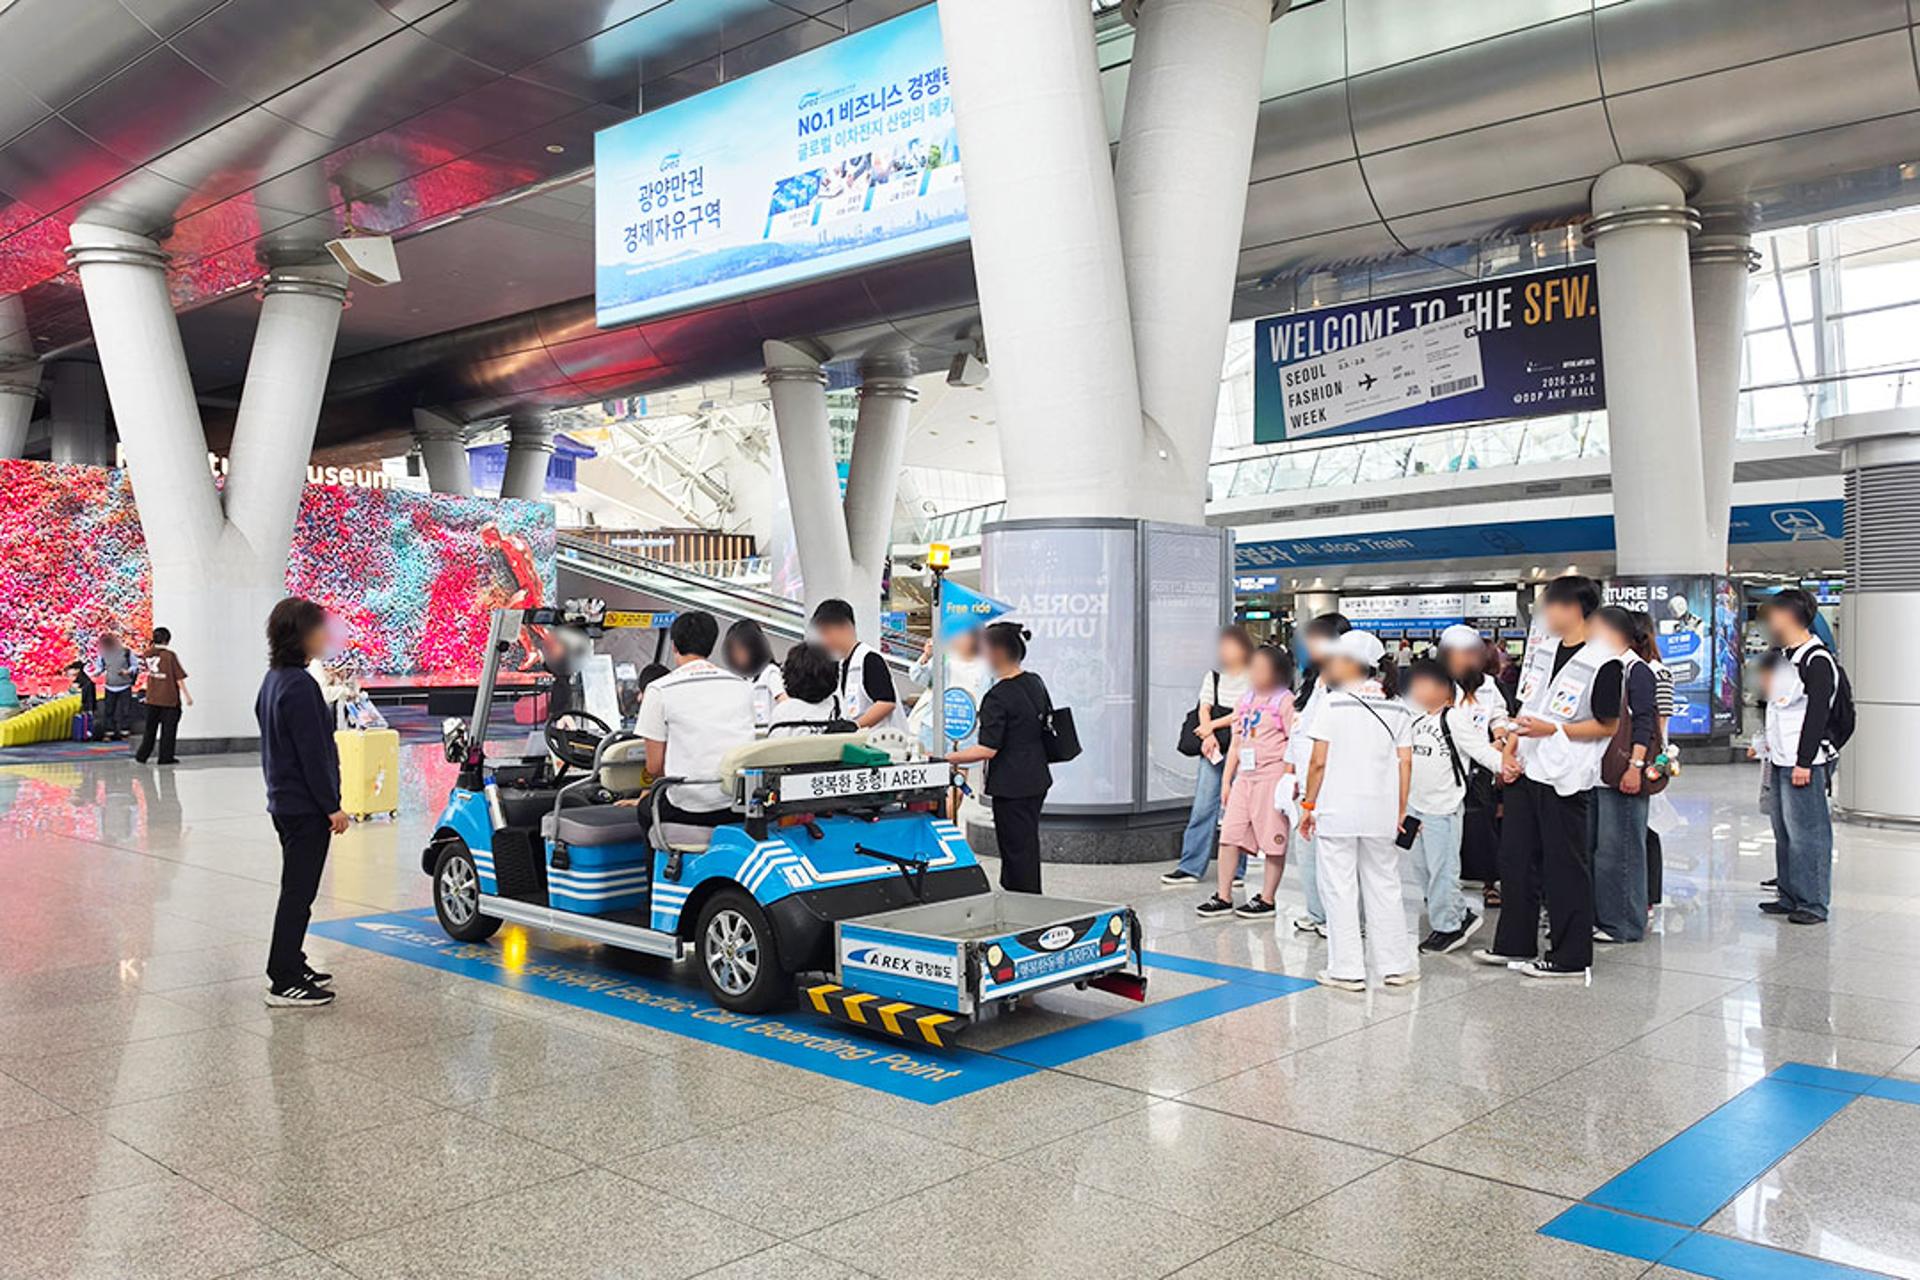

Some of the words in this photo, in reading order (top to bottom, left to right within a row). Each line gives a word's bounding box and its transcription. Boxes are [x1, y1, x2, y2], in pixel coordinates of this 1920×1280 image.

[797, 107, 835, 137] NO.1
[839, 84, 904, 122] 비즈니스
[797, 133, 832, 162] 글로벌
[834, 118, 884, 148] 이차전지
[886, 102, 926, 133] 산업의
[638, 165, 704, 213] 광양만권
[623, 198, 721, 253] 경제자유구역
[1269, 305, 1401, 363] WELCOME
[1410, 298, 1446, 329] TO
[1457, 287, 1513, 332] THE
[1523, 274, 1597, 325] SFW.
[1286, 363, 1327, 387] SEOUL
[1288, 380, 1343, 409] FASHION
[1570, 386, 1596, 397] HALL
[1290, 407, 1328, 430] WEEK
[306, 464, 395, 490] useum
[1359, 537, 1415, 551] Train
[1650, 586, 1669, 600] IS
[945, 602, 969, 614] Free
[971, 601, 993, 615] ride
[811, 774, 851, 797] 행복한
[855, 770, 887, 792] 동행!
[891, 769, 928, 787] AREX
[870, 953, 912, 972] AREX
[605, 983, 698, 1013] Electric
[691, 1008, 760, 1029] Cart
[744, 1021, 877, 1062] Boarding
[870, 1052, 963, 1084] Point
